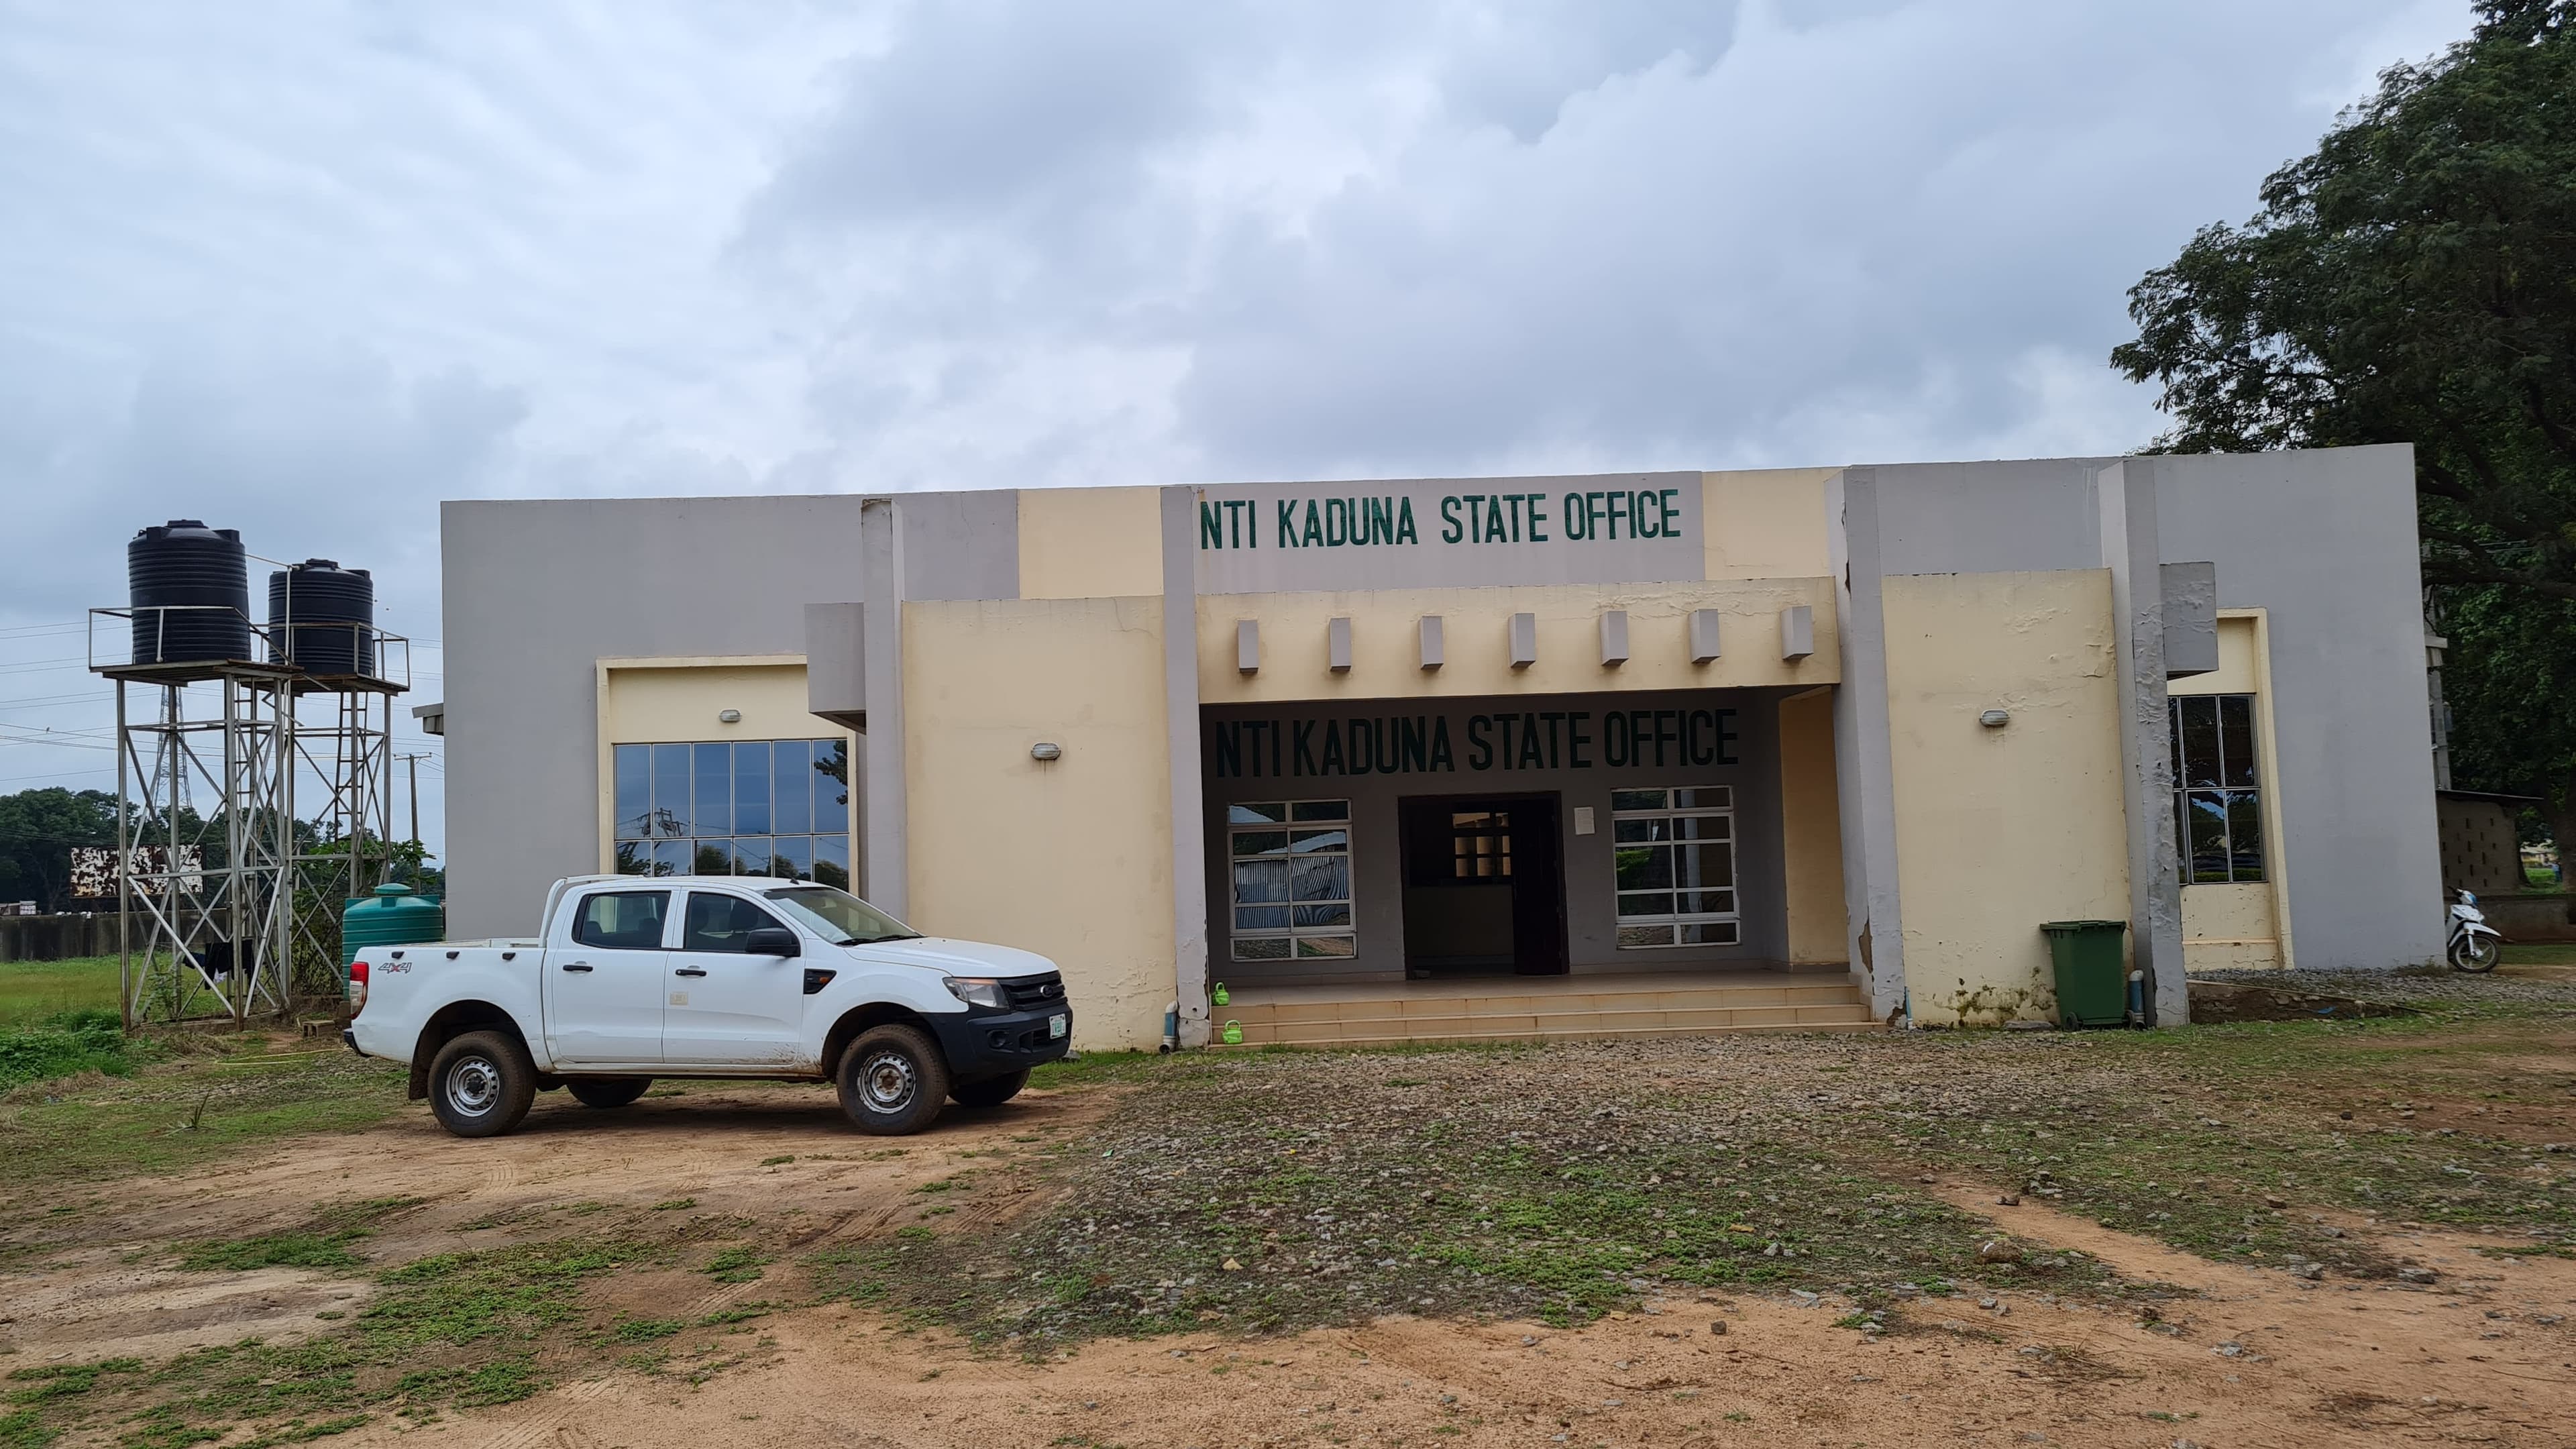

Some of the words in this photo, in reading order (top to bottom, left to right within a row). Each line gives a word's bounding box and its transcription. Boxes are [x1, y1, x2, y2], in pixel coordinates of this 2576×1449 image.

[1200, 500, 1256, 549] NTI
[1278, 496, 1418, 548] KADUNA
[1441, 493, 1548, 544] STATE
[1564, 489, 1680, 540] OFFICE
[1216, 720, 1281, 778] NTI
[1293, 714, 1456, 777] KADUNA
[1468, 712, 1591, 771] STATE
[1604, 708, 1739, 767] OFFICE
